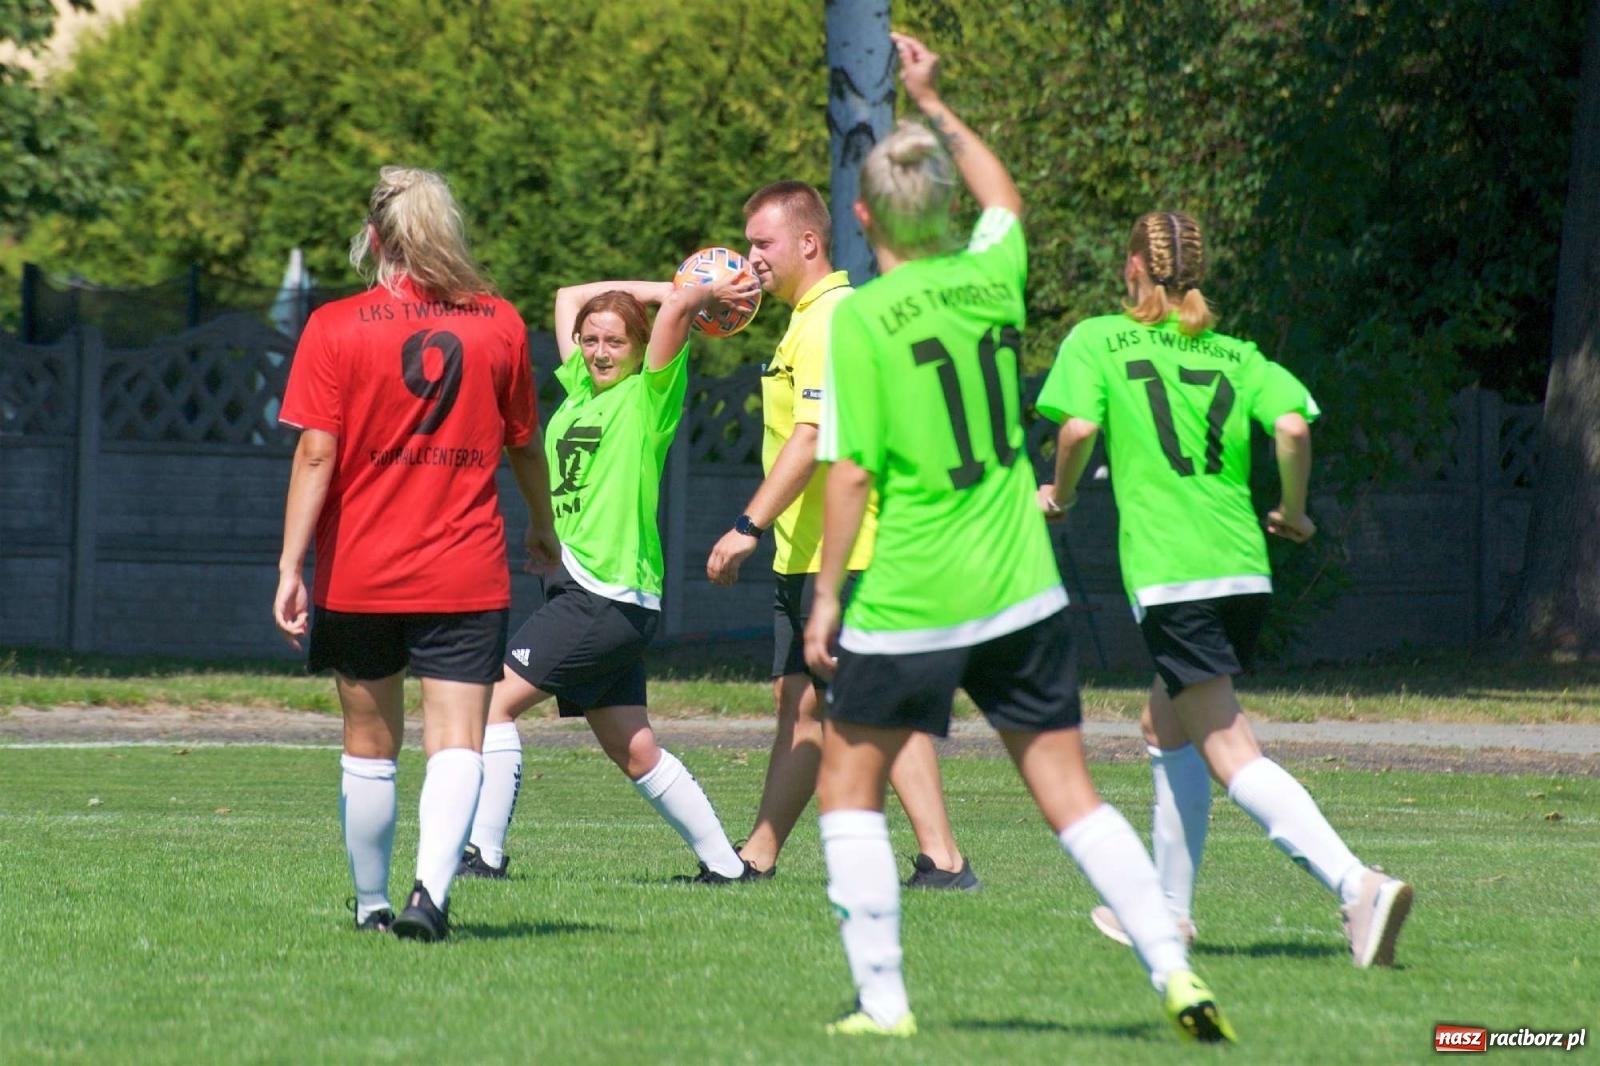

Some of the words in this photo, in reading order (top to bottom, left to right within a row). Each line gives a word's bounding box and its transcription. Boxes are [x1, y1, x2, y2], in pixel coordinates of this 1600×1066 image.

[359, 303, 394, 322] LKS
[880, 296, 921, 336] LKS
[1106, 330, 1140, 352] LKS
[401, 328, 464, 436] 9
[910, 323, 1021, 491] 10
[1125, 359, 1236, 477] 17
